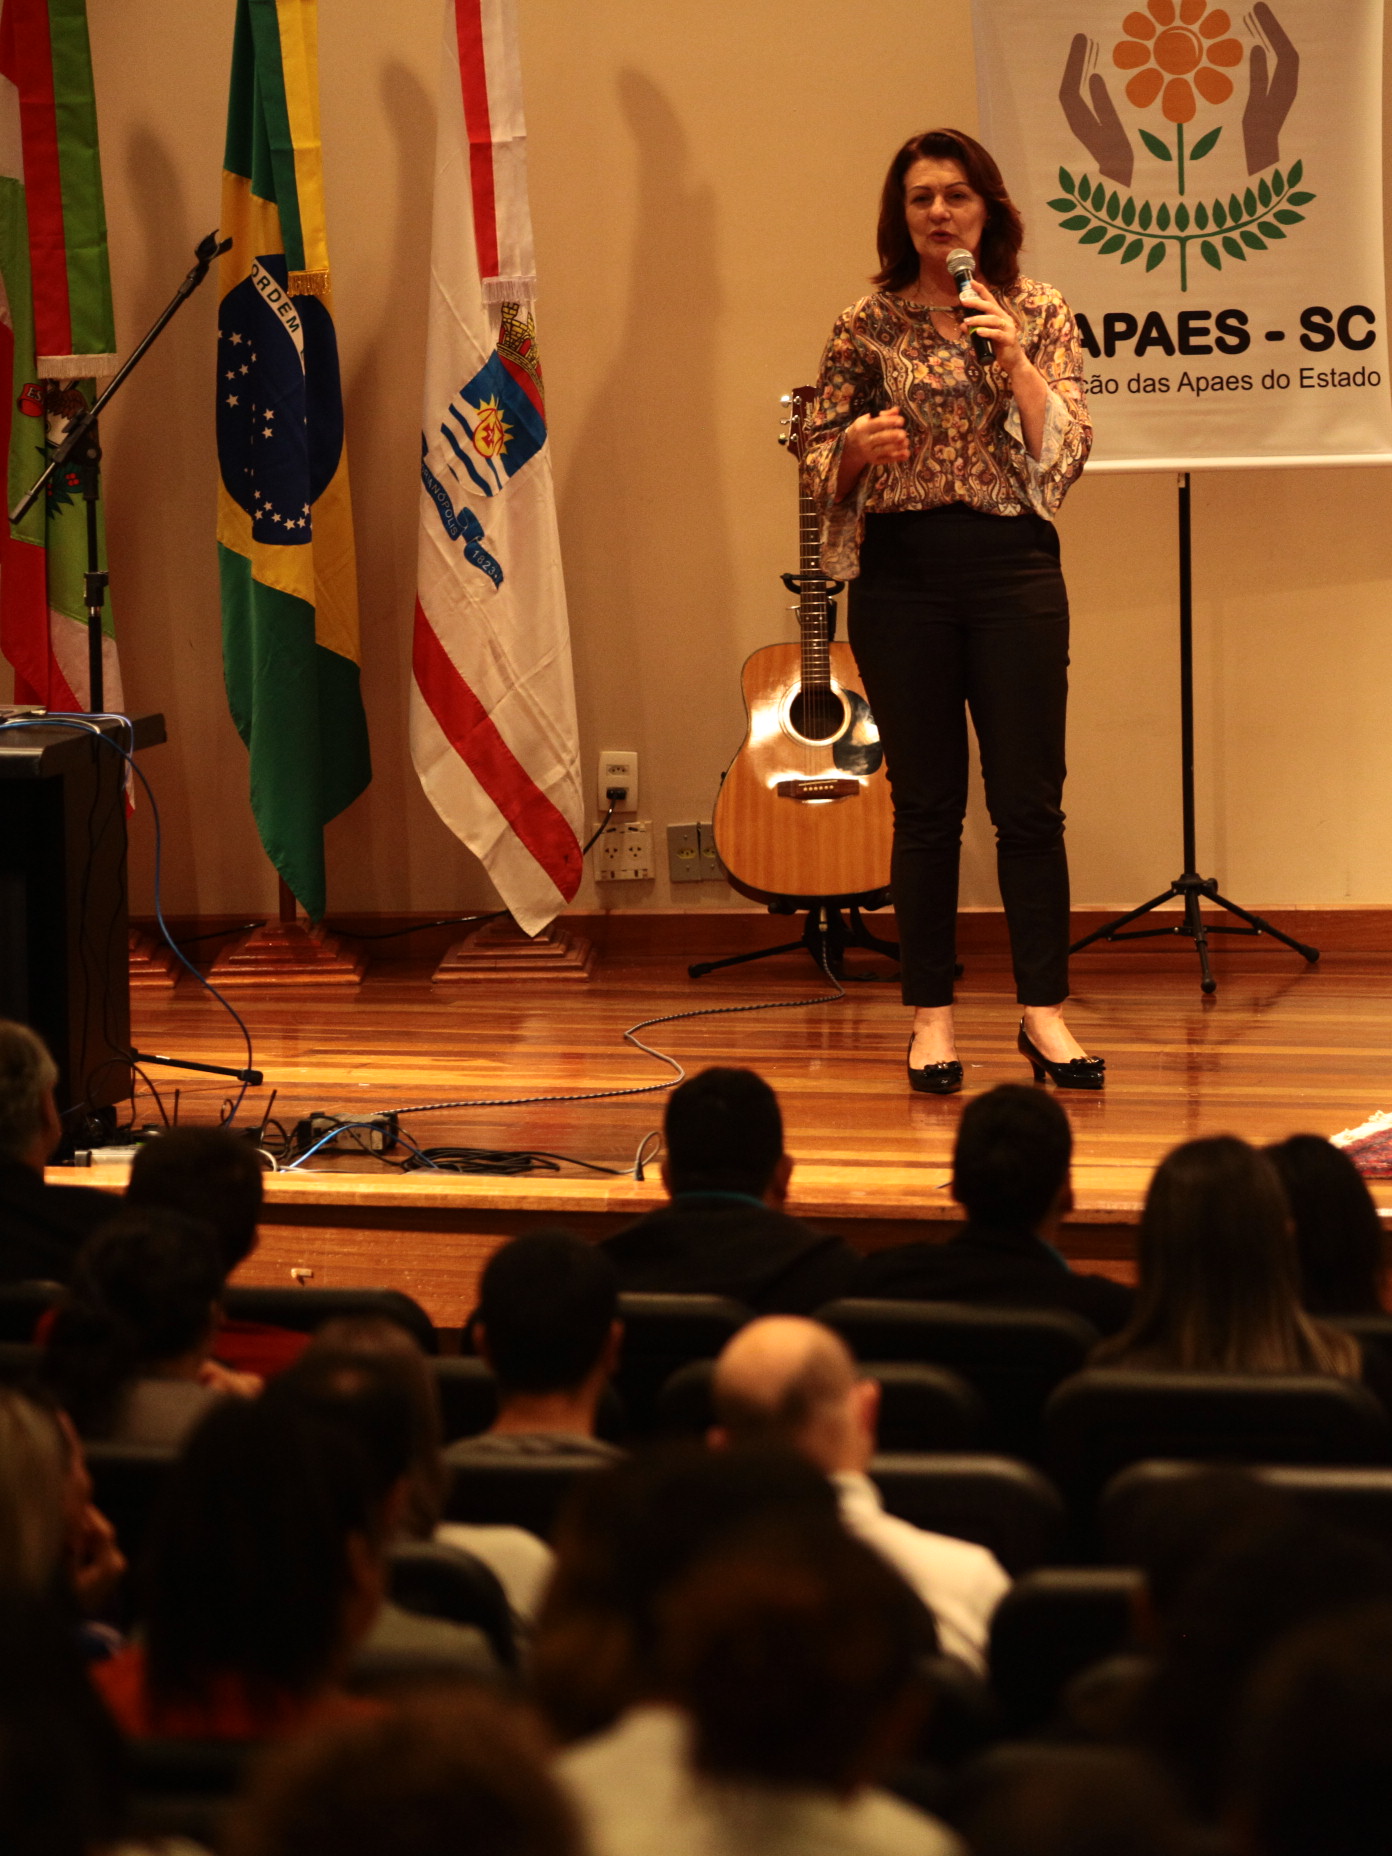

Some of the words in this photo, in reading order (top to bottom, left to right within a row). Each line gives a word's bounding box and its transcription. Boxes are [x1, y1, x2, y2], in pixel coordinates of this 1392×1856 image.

[251, 263, 301, 333] ORDEM
[1073, 308, 1251, 358] APAES
[1299, 304, 1377, 353] SC
[1127, 372, 1171, 394] das
[1176, 371, 1254, 398] Apaes
[1261, 368, 1291, 390] do
[1299, 365, 1382, 389] Estado
[471, 549, 496, 577] 1823
